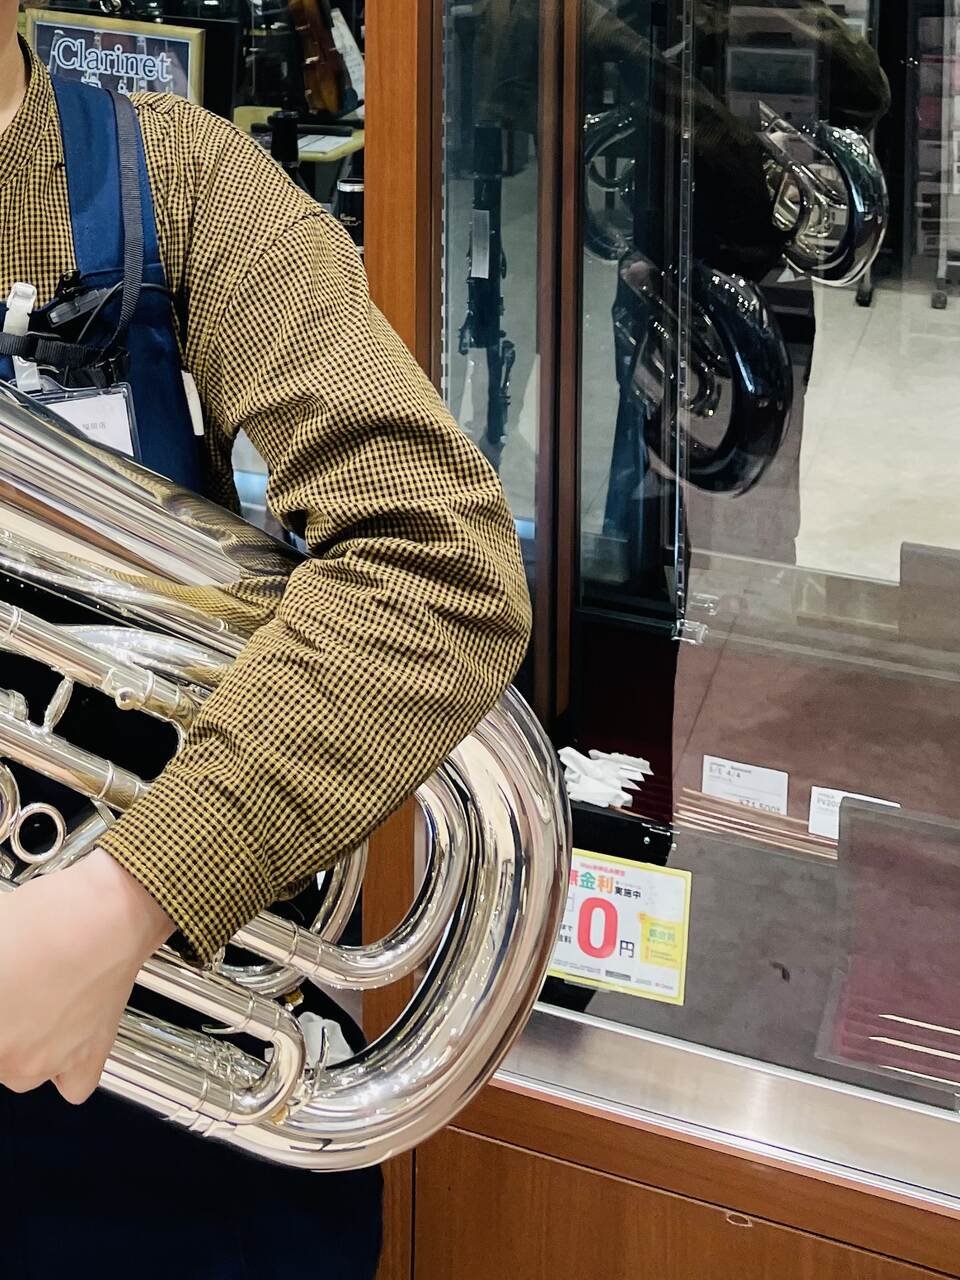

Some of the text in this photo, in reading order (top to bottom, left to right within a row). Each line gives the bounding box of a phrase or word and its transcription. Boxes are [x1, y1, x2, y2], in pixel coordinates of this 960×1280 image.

[54, 37, 173, 83] Clarinet
[615, 886, 641, 900] 実施中
[577, 896, 619, 959] 0
